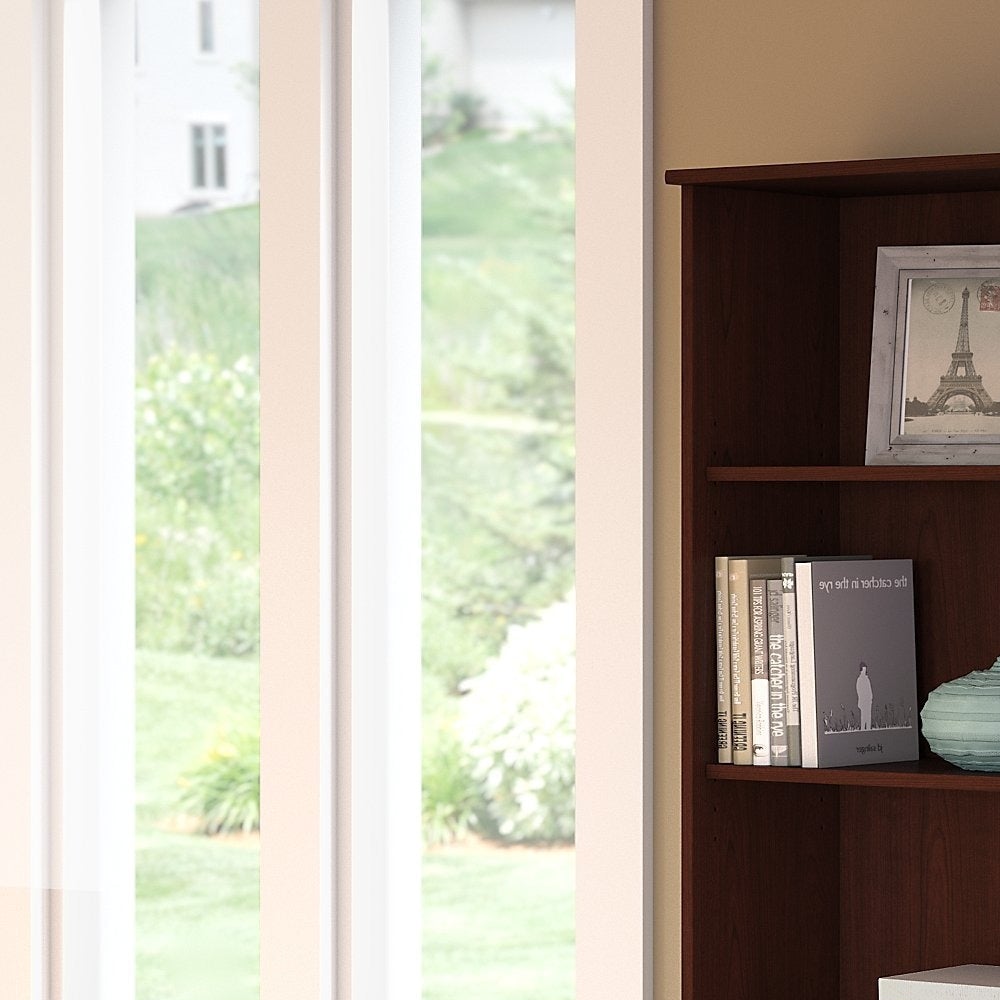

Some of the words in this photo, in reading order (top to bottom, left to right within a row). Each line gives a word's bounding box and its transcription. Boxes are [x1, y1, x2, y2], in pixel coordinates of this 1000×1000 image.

[753, 586, 762, 595] 101
[753, 596, 762, 605] TIPS
[753, 606, 763, 615] FOR
[769, 634, 784, 650] the
[770, 653, 785, 689] catcher
[770, 691, 782, 700] in
[771, 702, 786, 718] the
[771, 720, 784, 737] rye
